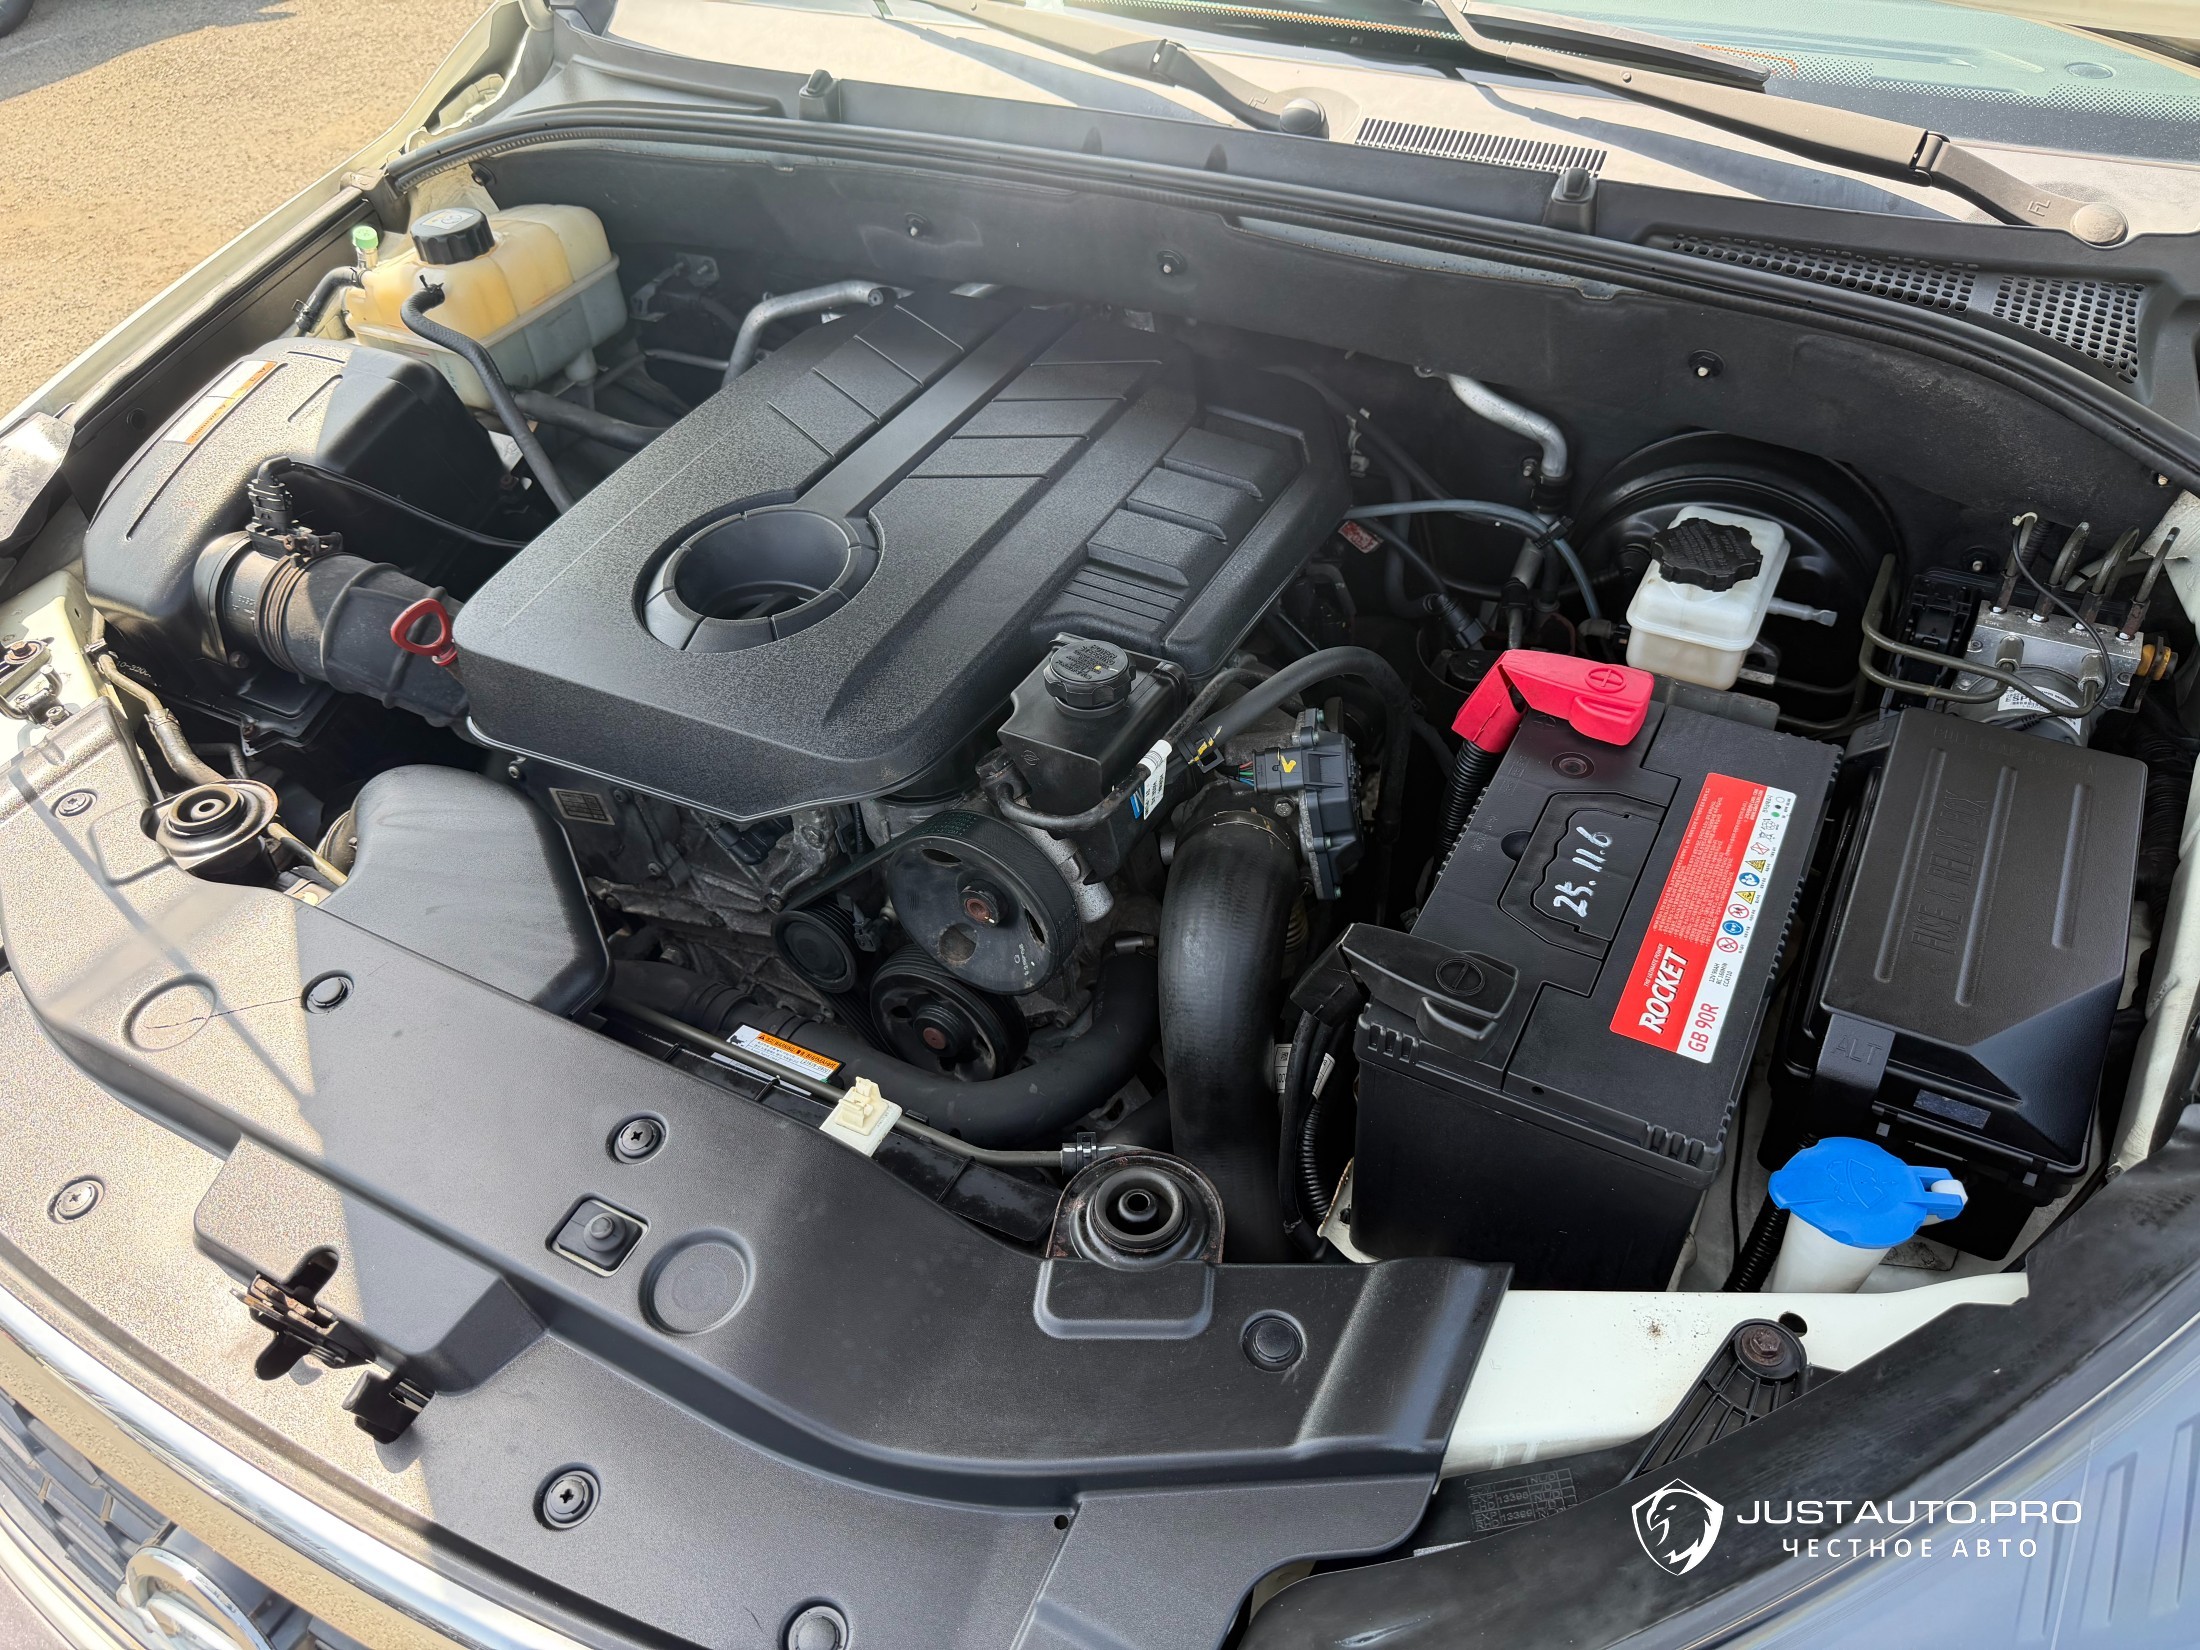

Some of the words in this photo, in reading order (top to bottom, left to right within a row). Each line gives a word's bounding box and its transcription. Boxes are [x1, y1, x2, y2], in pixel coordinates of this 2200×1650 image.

[2027, 200, 2051, 217] FL
[1938, 788, 1989, 828] BOX
[1924, 826, 1981, 886] RELAY
[1908, 902, 1964, 955] FUSE
[1638, 946, 1689, 1035] ROCKET
[1688, 1032, 1709, 1053] GB
[1699, 1003, 1720, 1030] 90R
[1831, 1034, 1882, 1065] ALT
[1472, 1492, 1494, 1505] EXP
[1474, 1501, 1496, 1512] LHD
[1475, 1511, 1497, 1522] EXP
[1476, 1519, 1499, 1530] RHD
